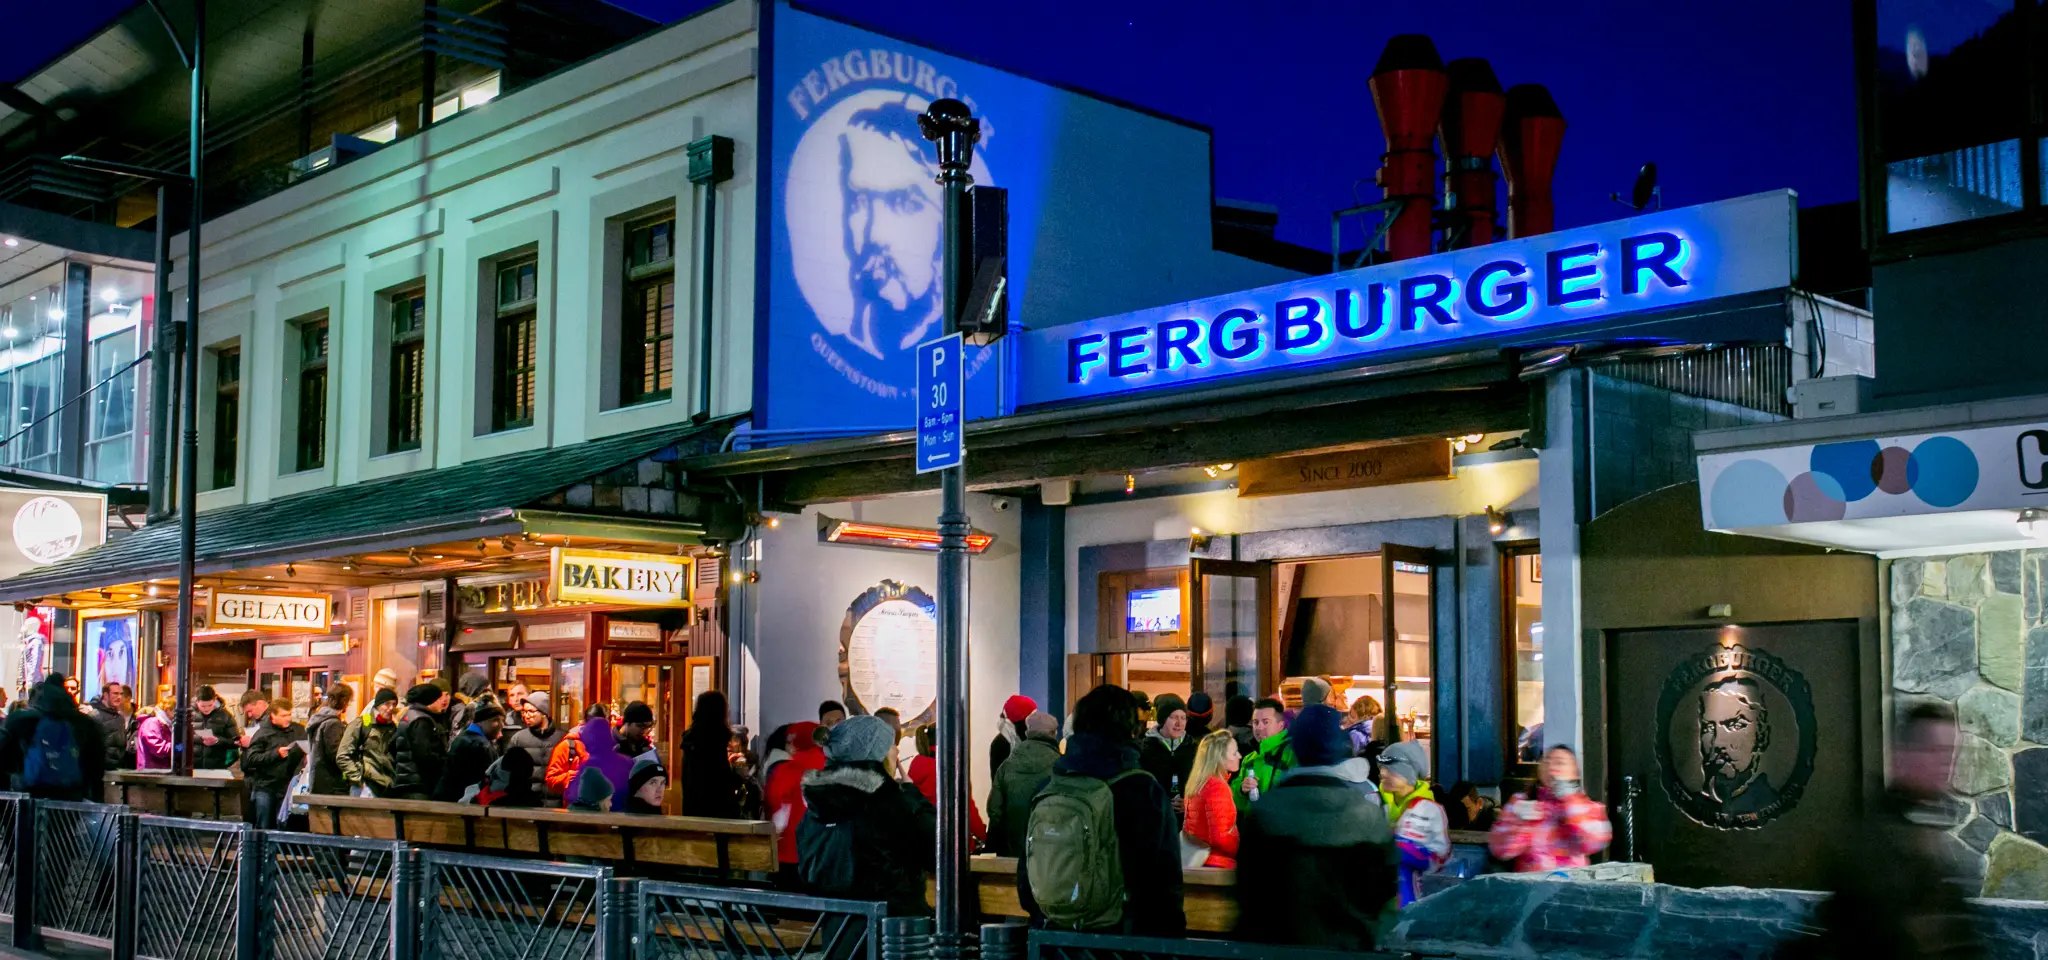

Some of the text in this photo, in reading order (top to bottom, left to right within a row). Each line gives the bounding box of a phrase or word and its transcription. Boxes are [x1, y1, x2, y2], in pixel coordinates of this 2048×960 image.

[1067, 231, 1689, 383] FERGBURGER
[811, 333, 898, 399] QUEENSTOWN
[932, 346, 946, 378] P
[931, 381, 948, 409] 30
[941, 412, 954, 426] 6pm
[923, 434, 937, 447] Mon
[942, 430, 955, 443] Sun
[1346, 459, 1382, 479] 2000
[563, 563, 682, 594] BAKERY
[221, 599, 320, 622] GELATO
